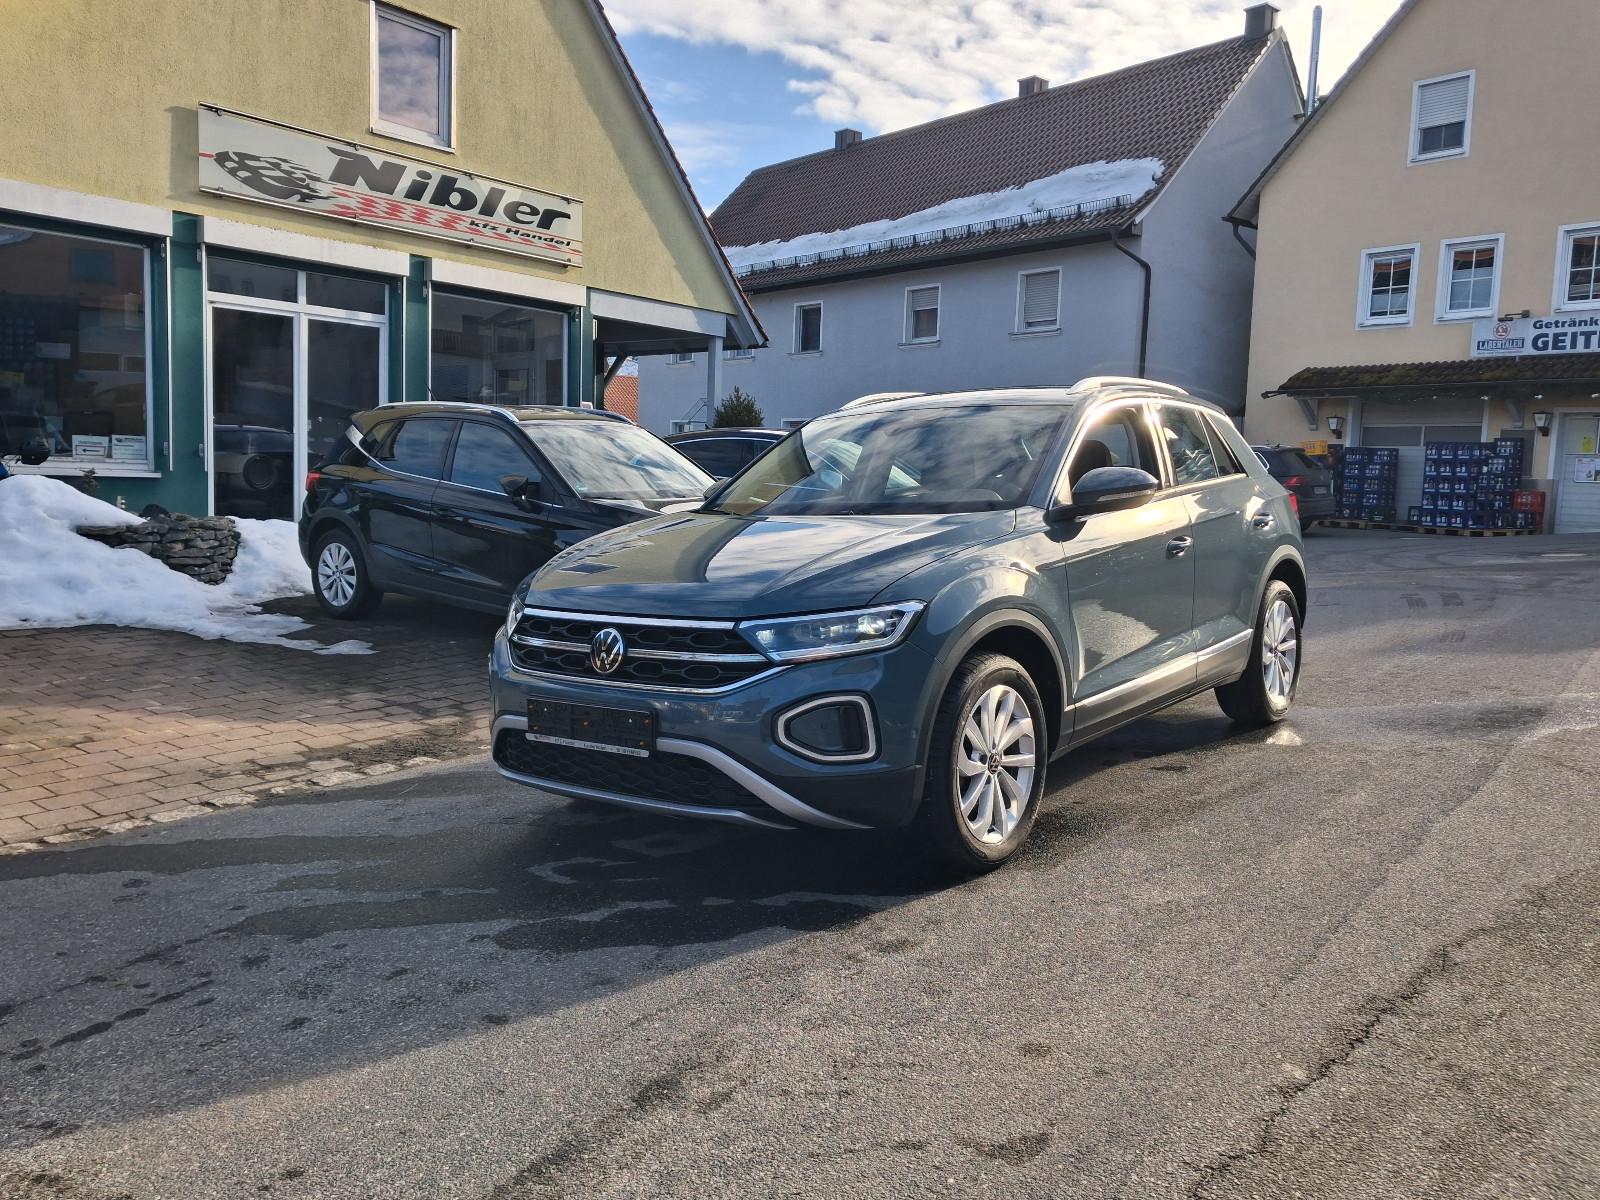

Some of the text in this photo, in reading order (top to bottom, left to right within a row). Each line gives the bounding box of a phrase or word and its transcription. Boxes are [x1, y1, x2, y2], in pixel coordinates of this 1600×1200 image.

[327, 146, 571, 230] Nibler
[505, 228, 571, 247] Handel
[1532, 316, 1600, 330] Getränk
[1531, 330, 1600, 352] GEIT
